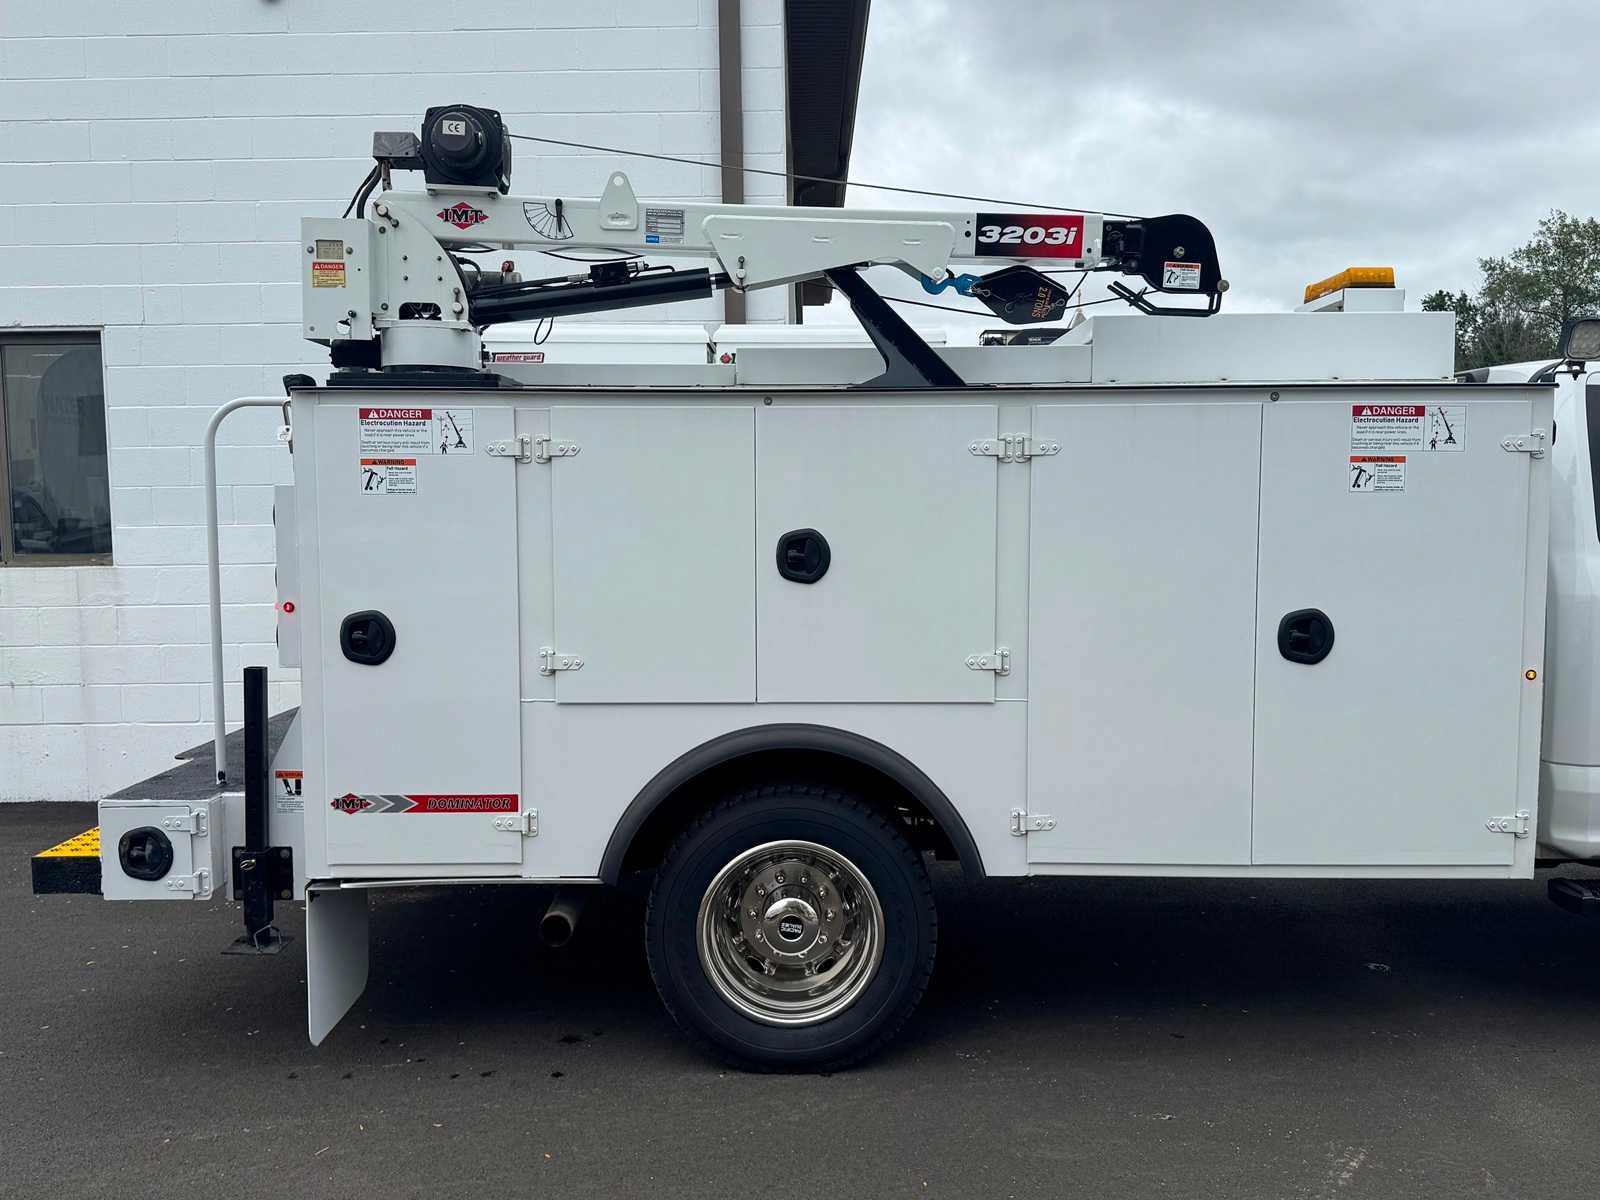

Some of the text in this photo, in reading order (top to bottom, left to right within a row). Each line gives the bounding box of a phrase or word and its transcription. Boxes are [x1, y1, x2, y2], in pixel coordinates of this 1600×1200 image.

[448, 122, 460, 132] CE
[442, 207, 482, 224] IMT
[978, 225, 1078, 246] 3203i
[379, 410, 422, 418] DANGER
[1373, 407, 1416, 415] DANGER
[335, 797, 512, 810] IMT DOMINATOR
